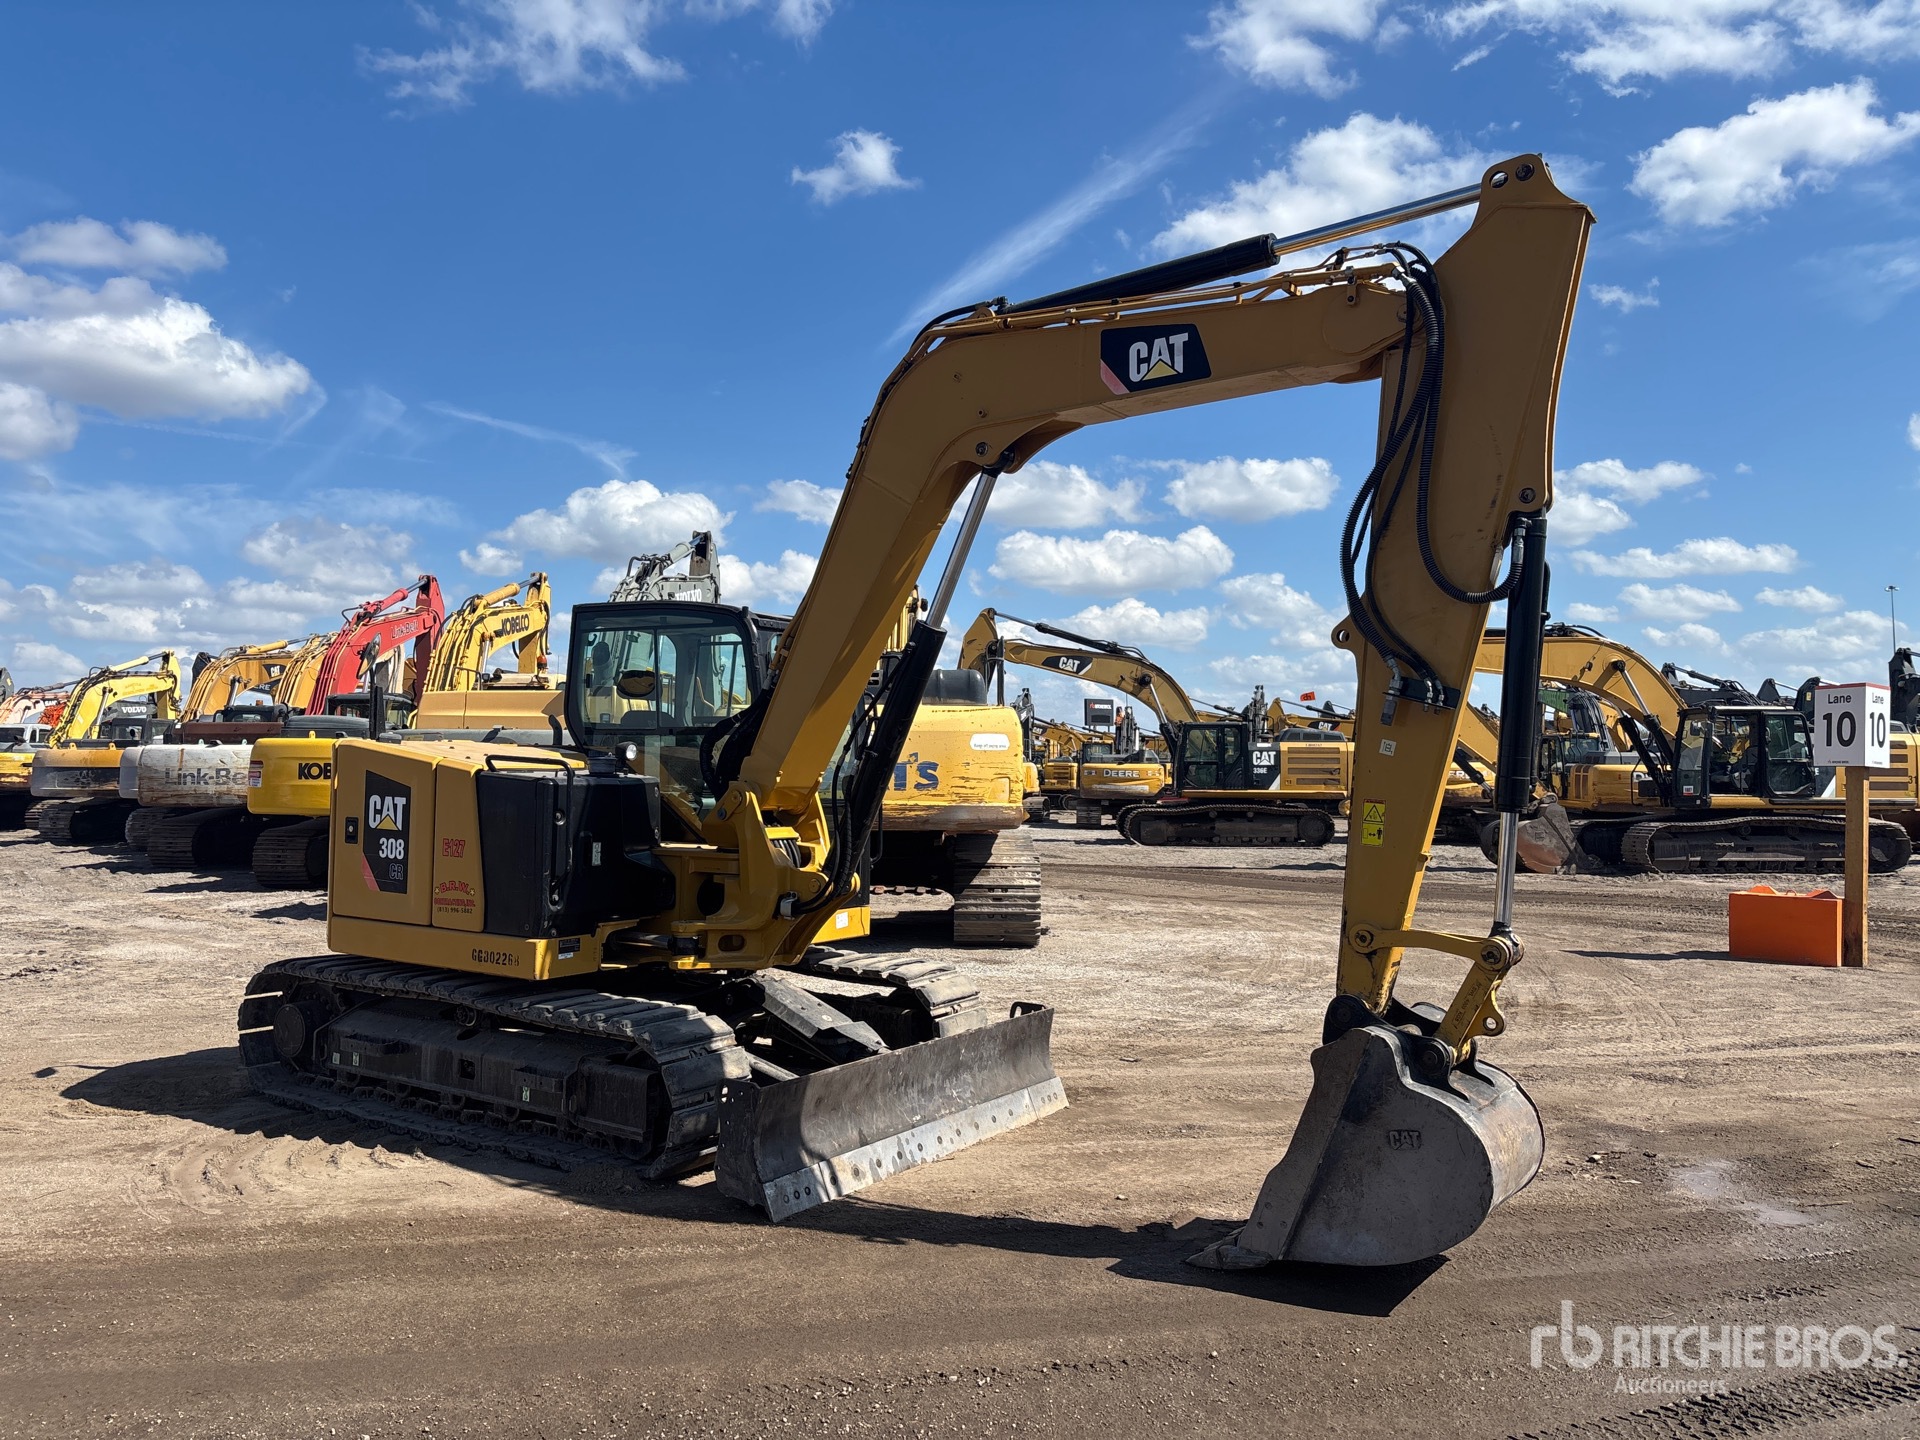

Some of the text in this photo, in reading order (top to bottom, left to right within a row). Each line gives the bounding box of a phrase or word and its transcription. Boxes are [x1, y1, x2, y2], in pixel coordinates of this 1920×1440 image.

[1129, 332, 1189, 383] CAT
[501, 613, 530, 636] KOBELCO
[270, 665, 281, 678] CAT
[1058, 656, 1081, 673] CAT
[1828, 693, 1852, 704] Lane
[1872, 692, 1884, 705] Lane
[1032, 726, 1043, 735] CAT
[1318, 721, 1333, 731] CAT
[1822, 711, 1856, 748] 10
[1869, 711, 1886, 748] 10
[1252, 751, 1276, 766] CAT
[298, 763, 332, 780] KOB
[1103, 769, 1140, 778] DEERE
[368, 794, 407, 831] CAT
[378, 838, 405, 860] 308
[442, 838, 466, 858] E127
[389, 863, 404, 880] CR
[440, 880, 470, 895] B.R.W.
[1389, 1130, 1421, 1150] CAT
